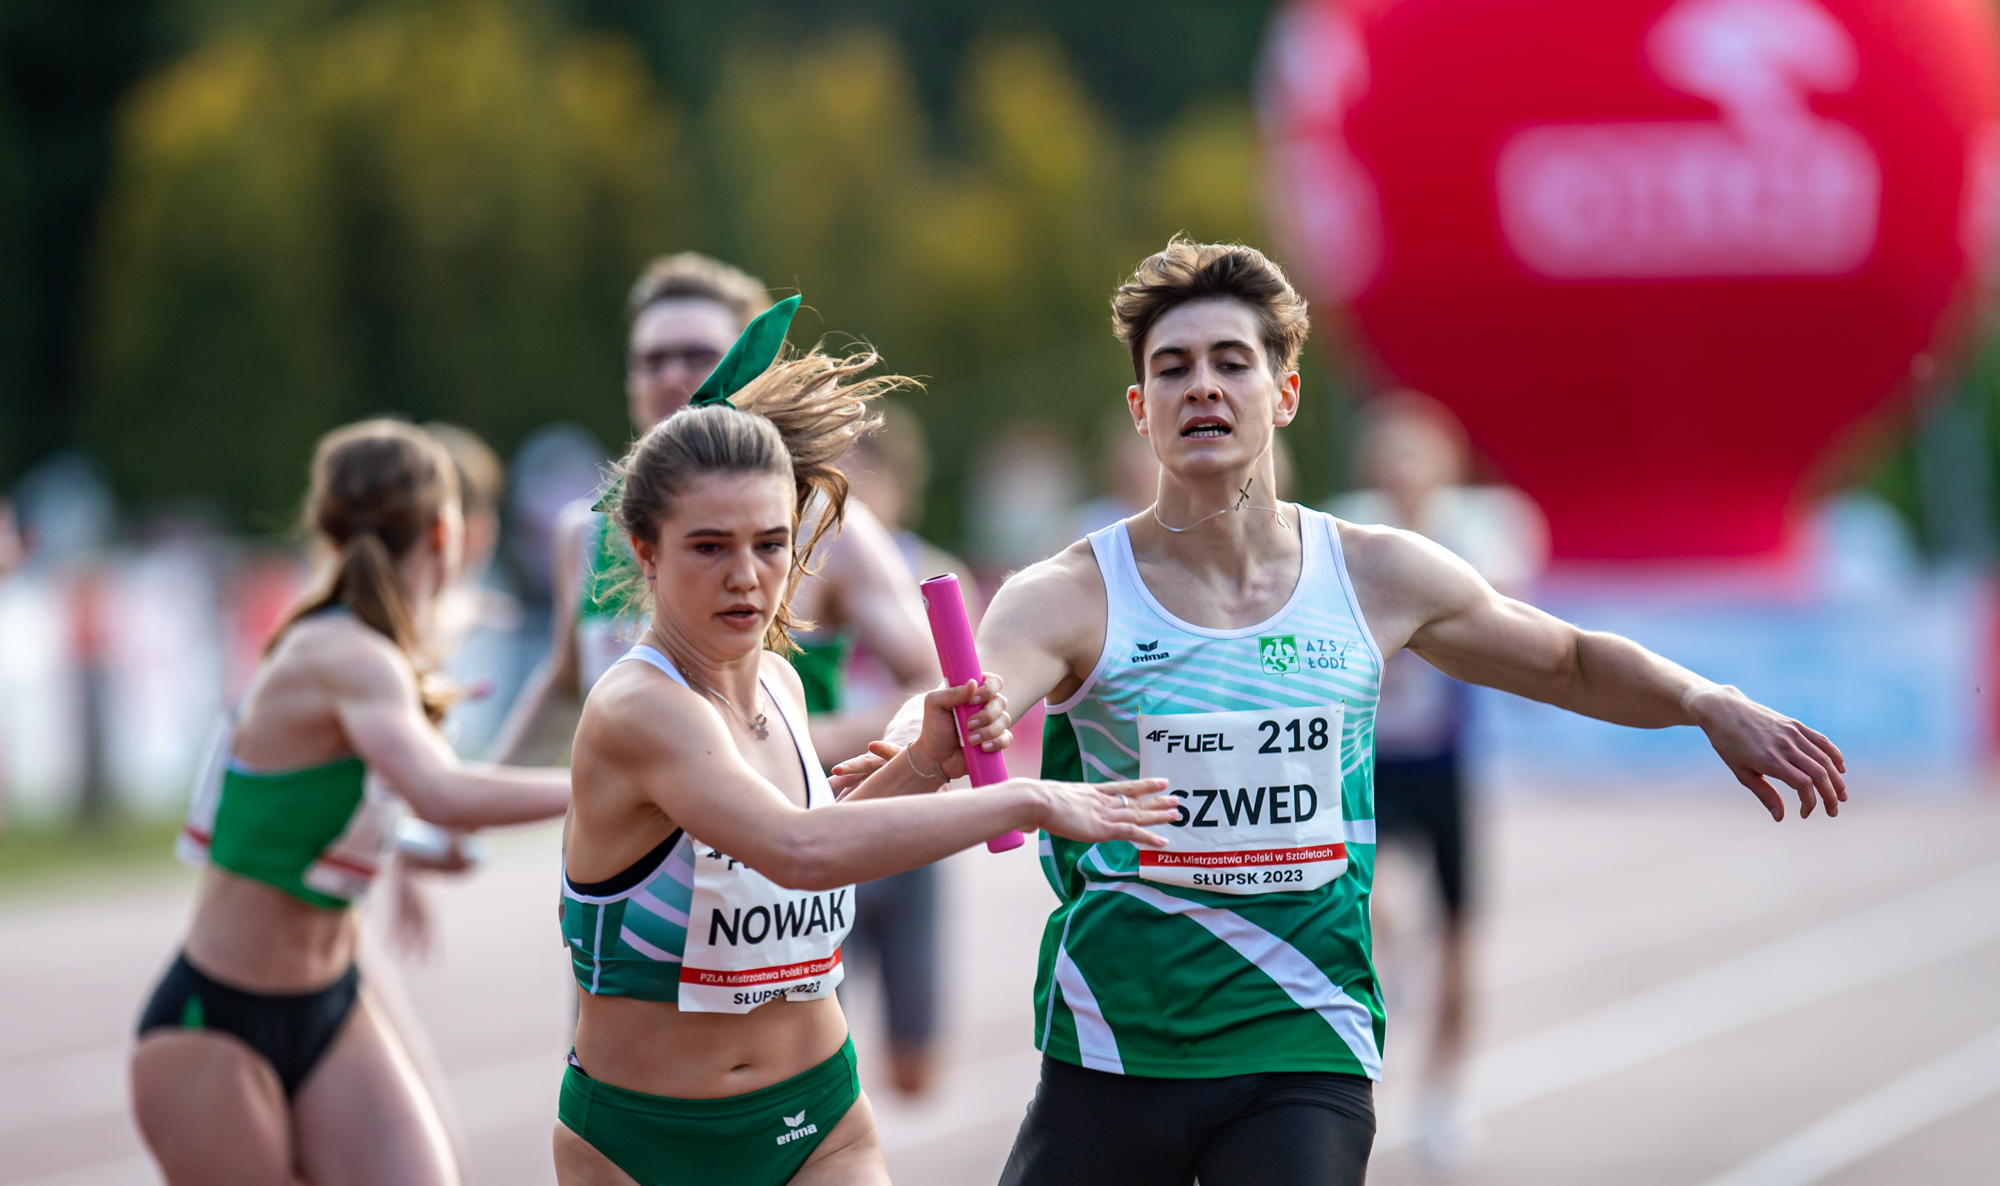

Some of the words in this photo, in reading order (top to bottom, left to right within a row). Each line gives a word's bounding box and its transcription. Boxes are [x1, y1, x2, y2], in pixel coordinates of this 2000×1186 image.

[1306, 639, 1337, 652] AZS
[1131, 651, 1170, 664] erima
[1258, 716, 1329, 754] 218
[1168, 783, 1318, 828] SZWED
[1158, 854, 1181, 864] PZLA
[1183, 854, 1242, 865] Mistrzostwa
[1244, 852, 1274, 863] Polski
[1275, 854, 1284, 862] w
[1286, 848, 1333, 861] Sztafetach
[1193, 872, 1259, 886] SŁUPSK
[1262, 869, 1304, 884] 2023
[708, 889, 847, 947] NOWAK
[700, 973, 724, 984] PZLA
[727, 971, 779, 984] Mistrzostwa
[780, 968, 802, 979] Polski
[803, 966, 810, 975] w
[776, 1123, 818, 1146] erima
